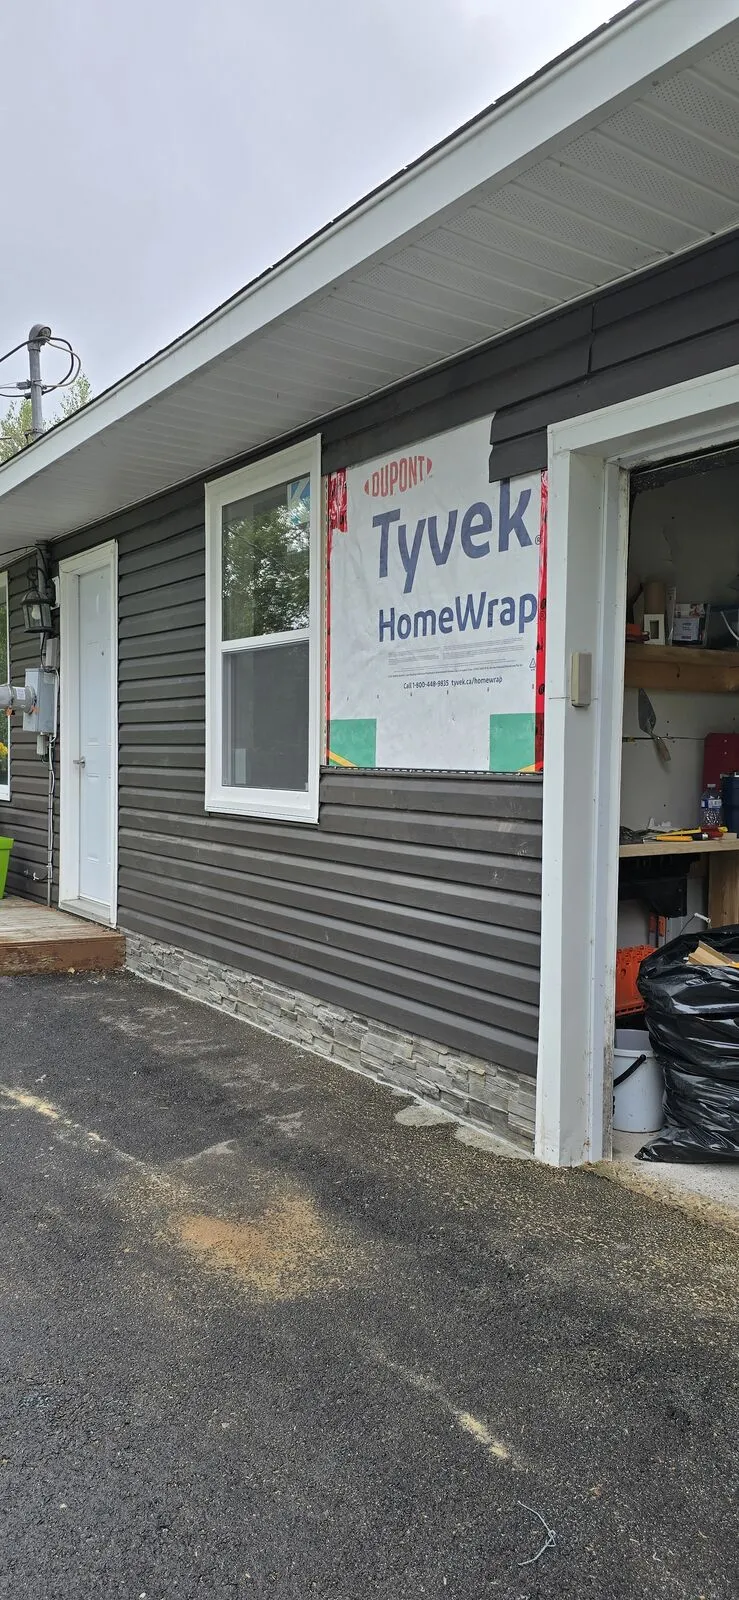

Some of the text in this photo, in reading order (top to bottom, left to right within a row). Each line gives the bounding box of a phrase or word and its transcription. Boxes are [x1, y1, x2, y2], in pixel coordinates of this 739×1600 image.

[371, 455, 425, 498] DUPONT
[372, 477, 533, 594] Tyvek
[379, 591, 538, 643] HomeWrap
[403, 682, 412, 690] Call
[451, 676, 503, 687] tyvek.ca/homewrap
